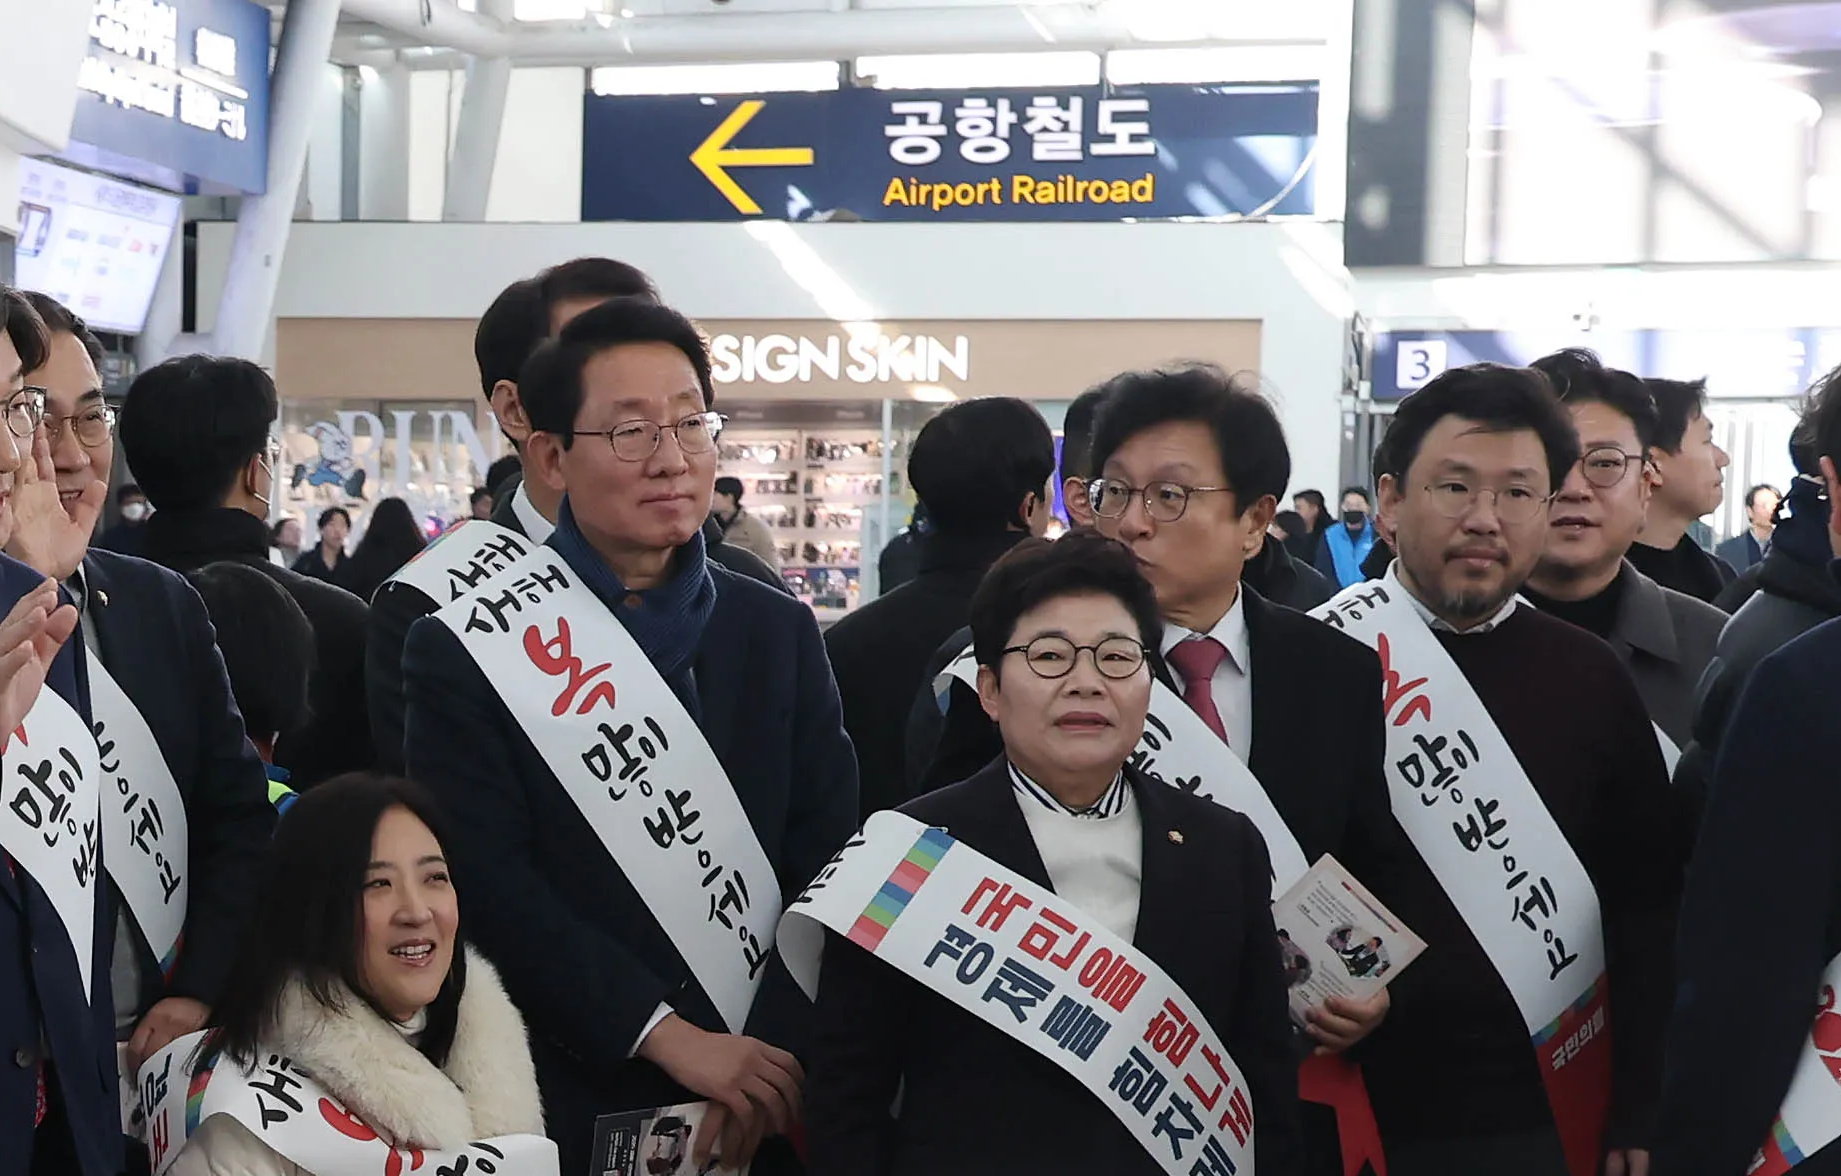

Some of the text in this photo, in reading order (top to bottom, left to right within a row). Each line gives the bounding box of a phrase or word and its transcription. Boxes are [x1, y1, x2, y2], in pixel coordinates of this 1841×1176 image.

[884, 96, 1156, 165] 공항철도
[883, 173, 1155, 211] Airport Railroad
[846, 334, 969, 383] SKIN
[1410, 349, 1431, 381] 3
[447, 534, 528, 602] 새해
[9, 747, 84, 848] 많이
[465, 564, 770, 981] 새해 복 많이 받으세요
[1396, 729, 1480, 807] 많이
[1452, 797, 1579, 981] 받으세요
[922, 922, 1113, 1063] 경제를
[960, 876, 1254, 1150] 국민을 힘나게
